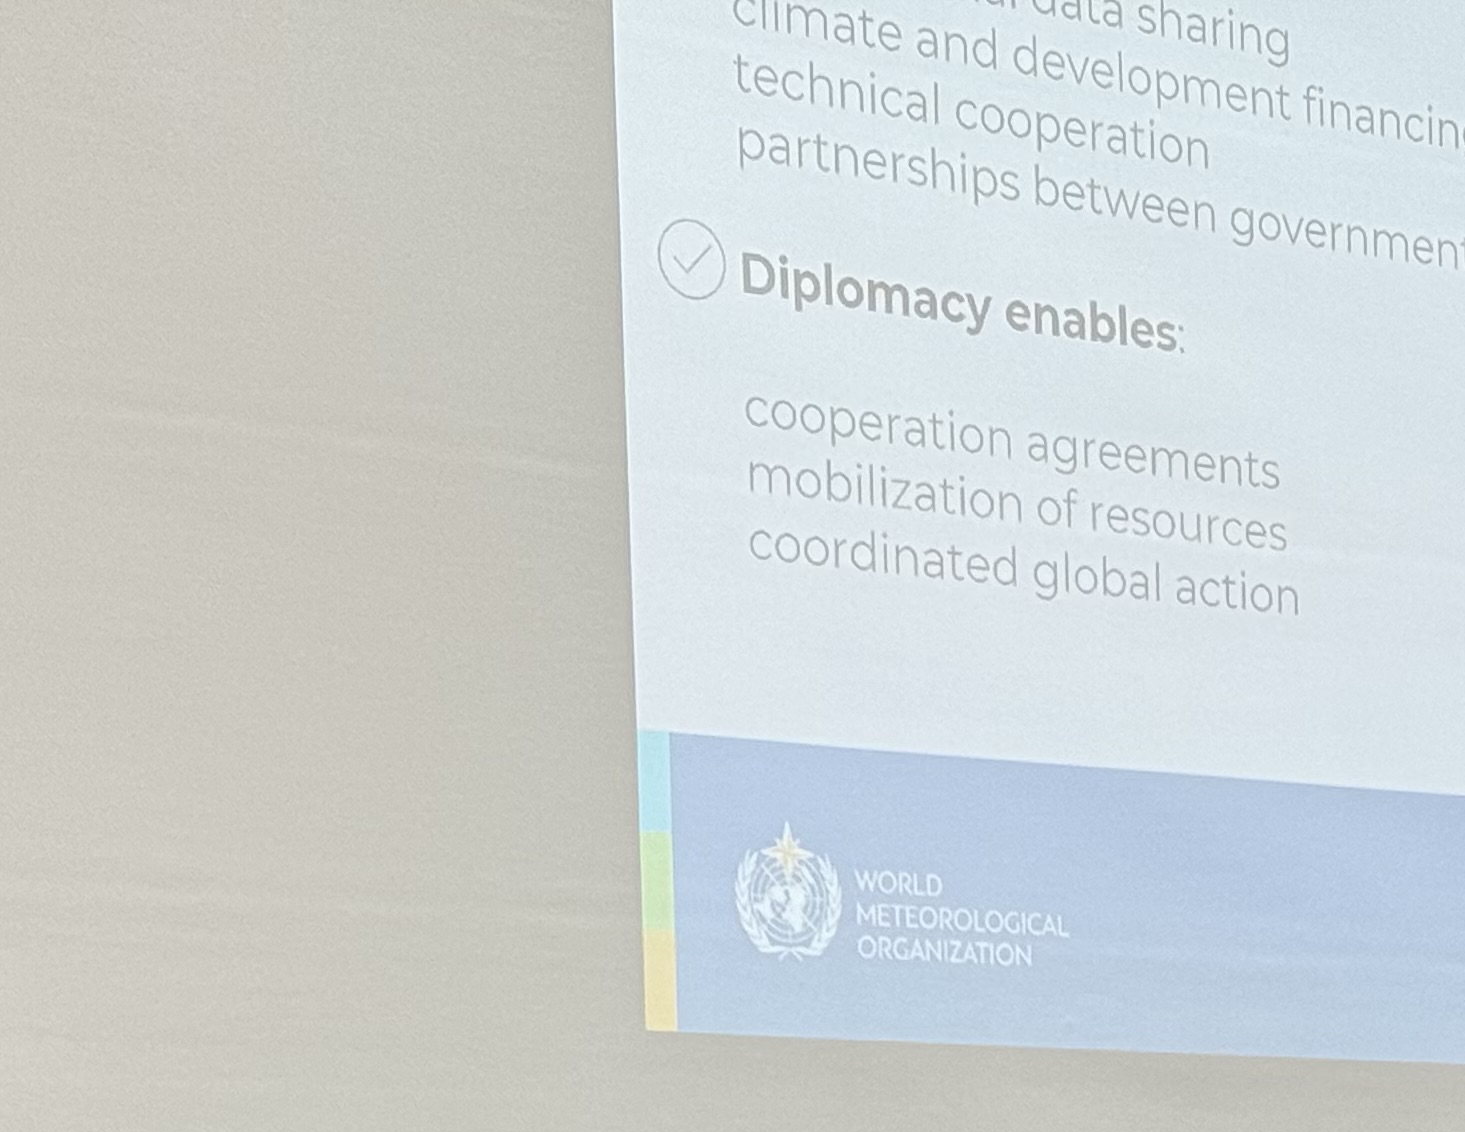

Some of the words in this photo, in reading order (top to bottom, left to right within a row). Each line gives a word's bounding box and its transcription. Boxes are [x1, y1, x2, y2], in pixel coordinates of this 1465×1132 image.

[732, 0, 903, 52] climate
[916, 27, 998, 71] and
[1012, 35, 1291, 121] development
[1137, 0, 1290, 67] sharing
[733, 52, 941, 126] technical
[955, 96, 1210, 169] cooperation
[738, 125, 1021, 207] partnerships
[1034, 164, 1217, 233] between
[741, 251, 992, 336] Diplomacy
[1005, 297, 1187, 354] enables:
[744, 394, 1013, 460] cooperation
[1026, 426, 1281, 491] agreements
[748, 458, 1022, 523] mobilization
[1036, 488, 1080, 528] of
[1089, 496, 1288, 552] resources
[749, 523, 1018, 588] coordinated
[1033, 551, 1162, 602] global
[1175, 570, 1300, 616] action
[854, 869, 943, 897] WORLD
[856, 902, 1071, 939] METEOROLOGICAL
[857, 935, 1034, 967] ORGANIZATION
